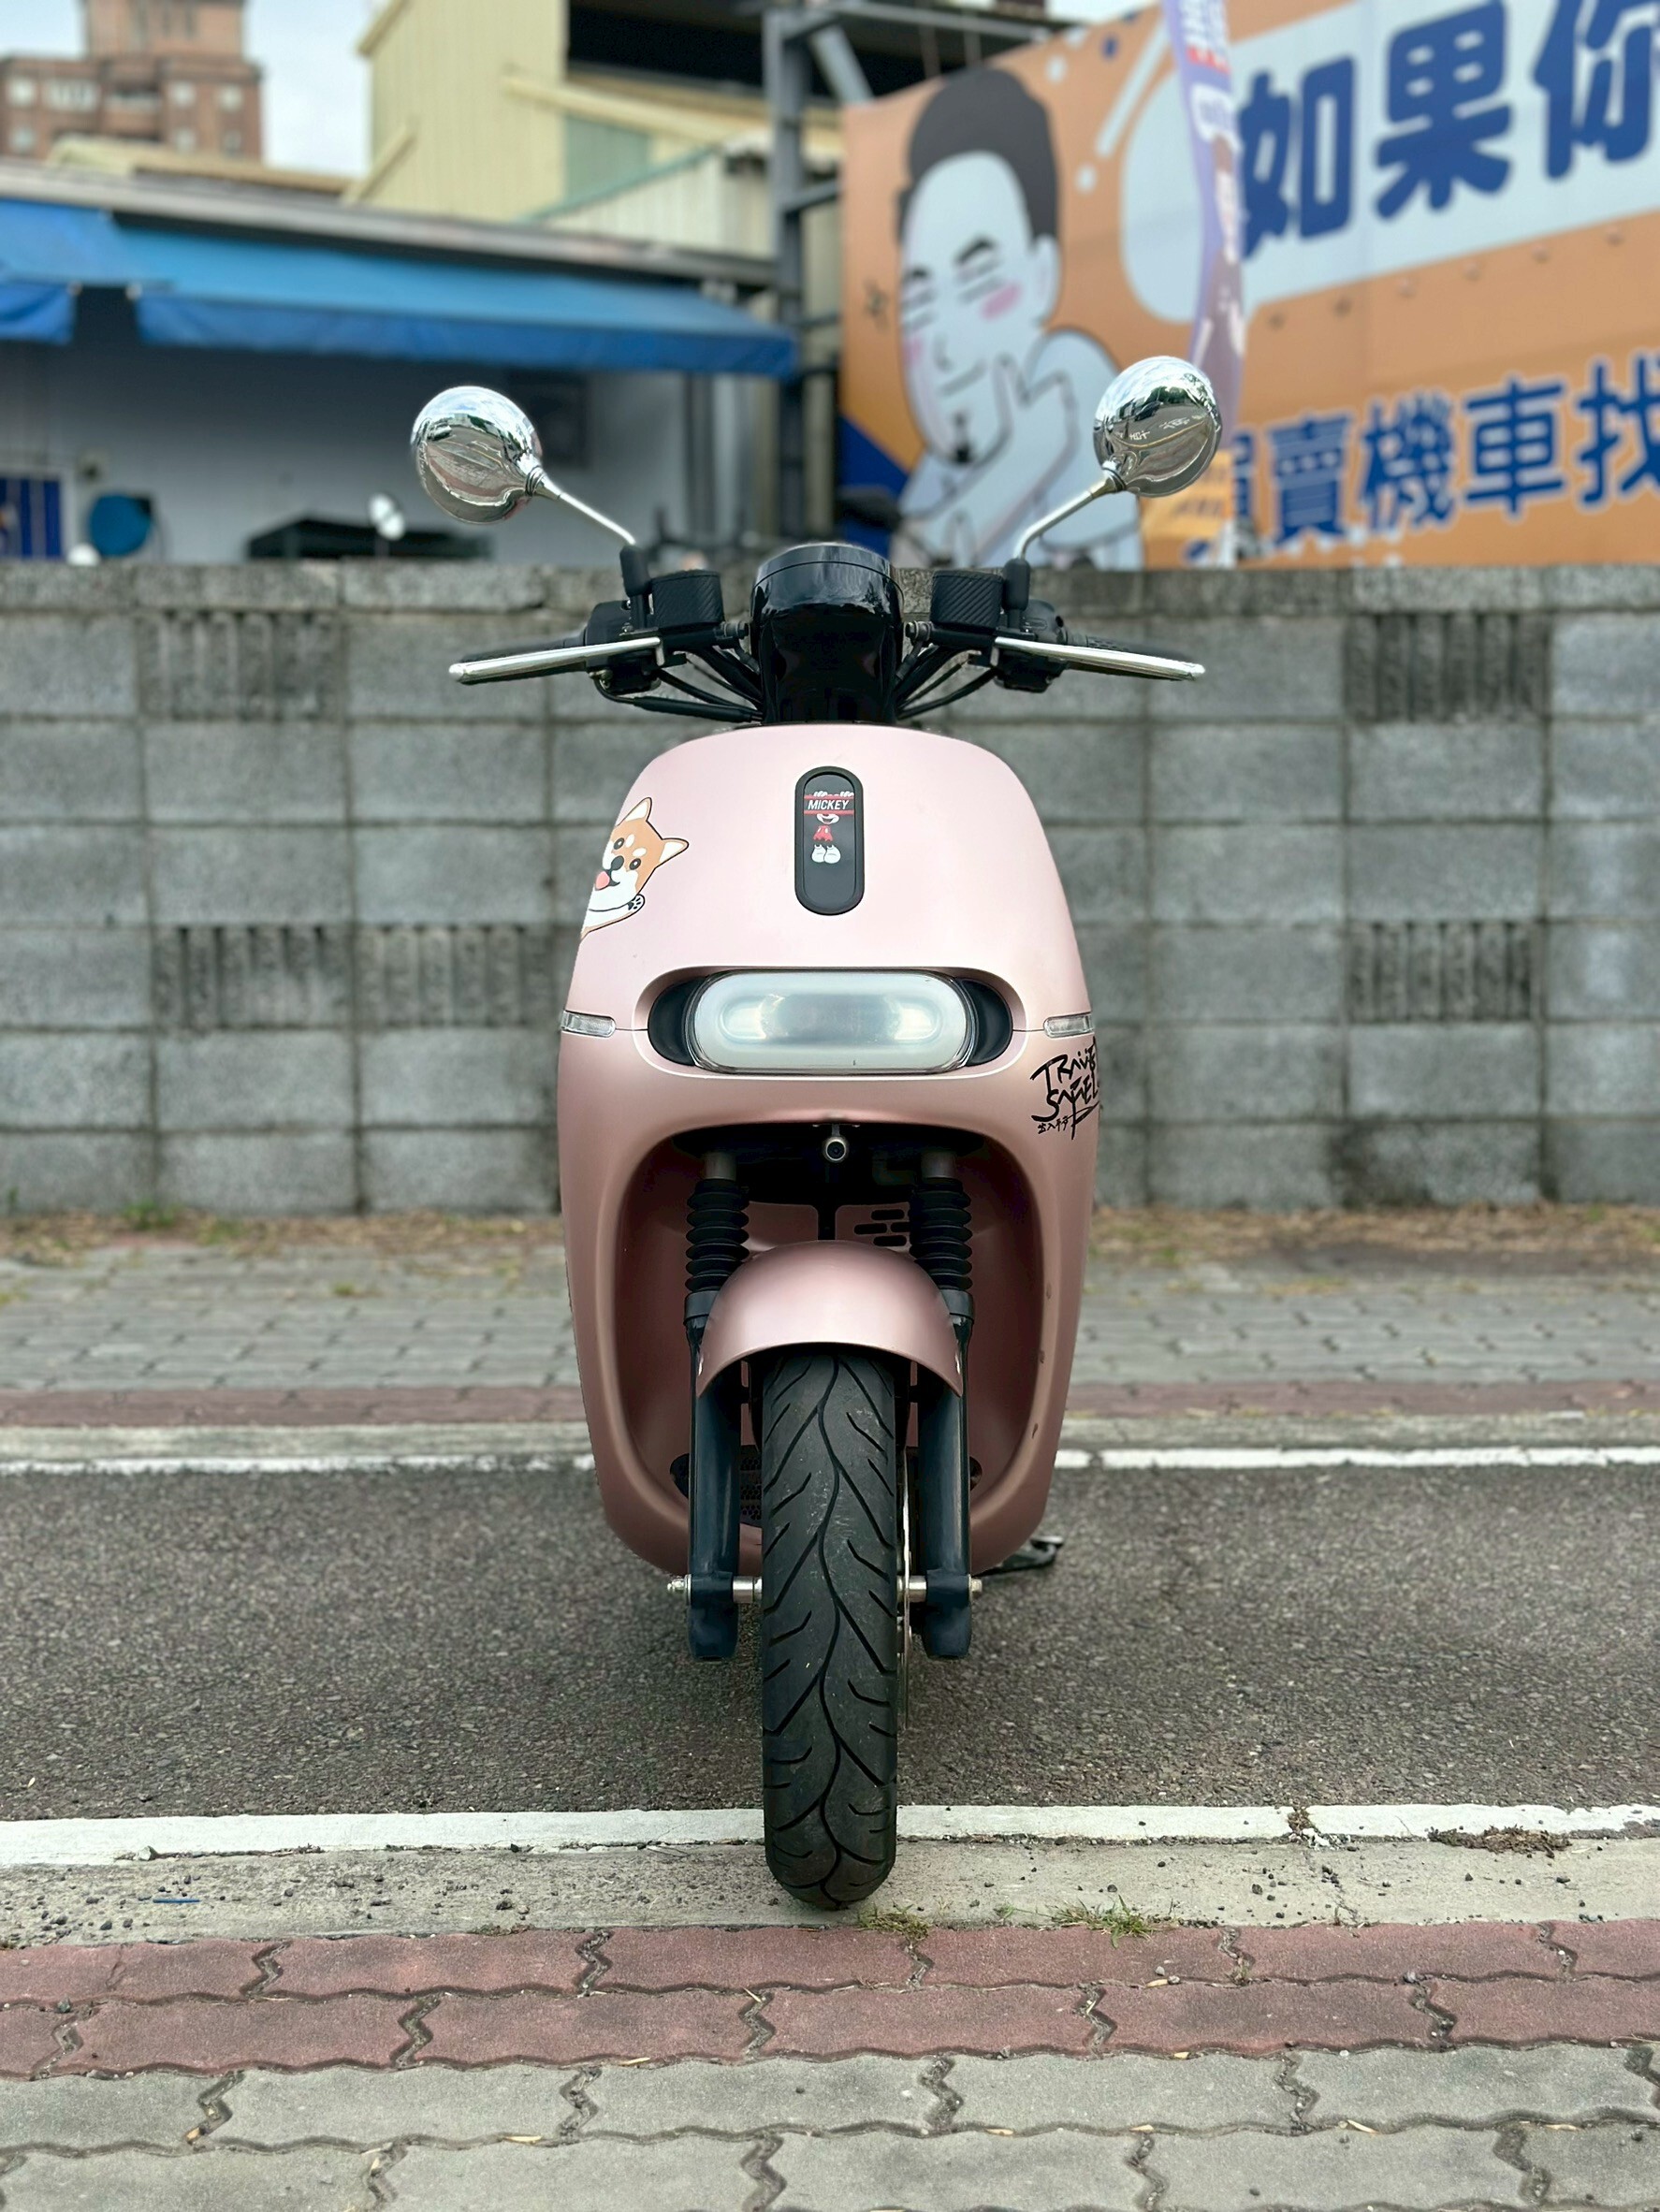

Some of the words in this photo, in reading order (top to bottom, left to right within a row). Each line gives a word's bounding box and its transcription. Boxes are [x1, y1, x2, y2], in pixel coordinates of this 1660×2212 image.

[1238, 0, 1660, 260] 如果你
[1233, 357, 1660, 548] 賣機車找
[807, 799, 849, 811] MICKEY
